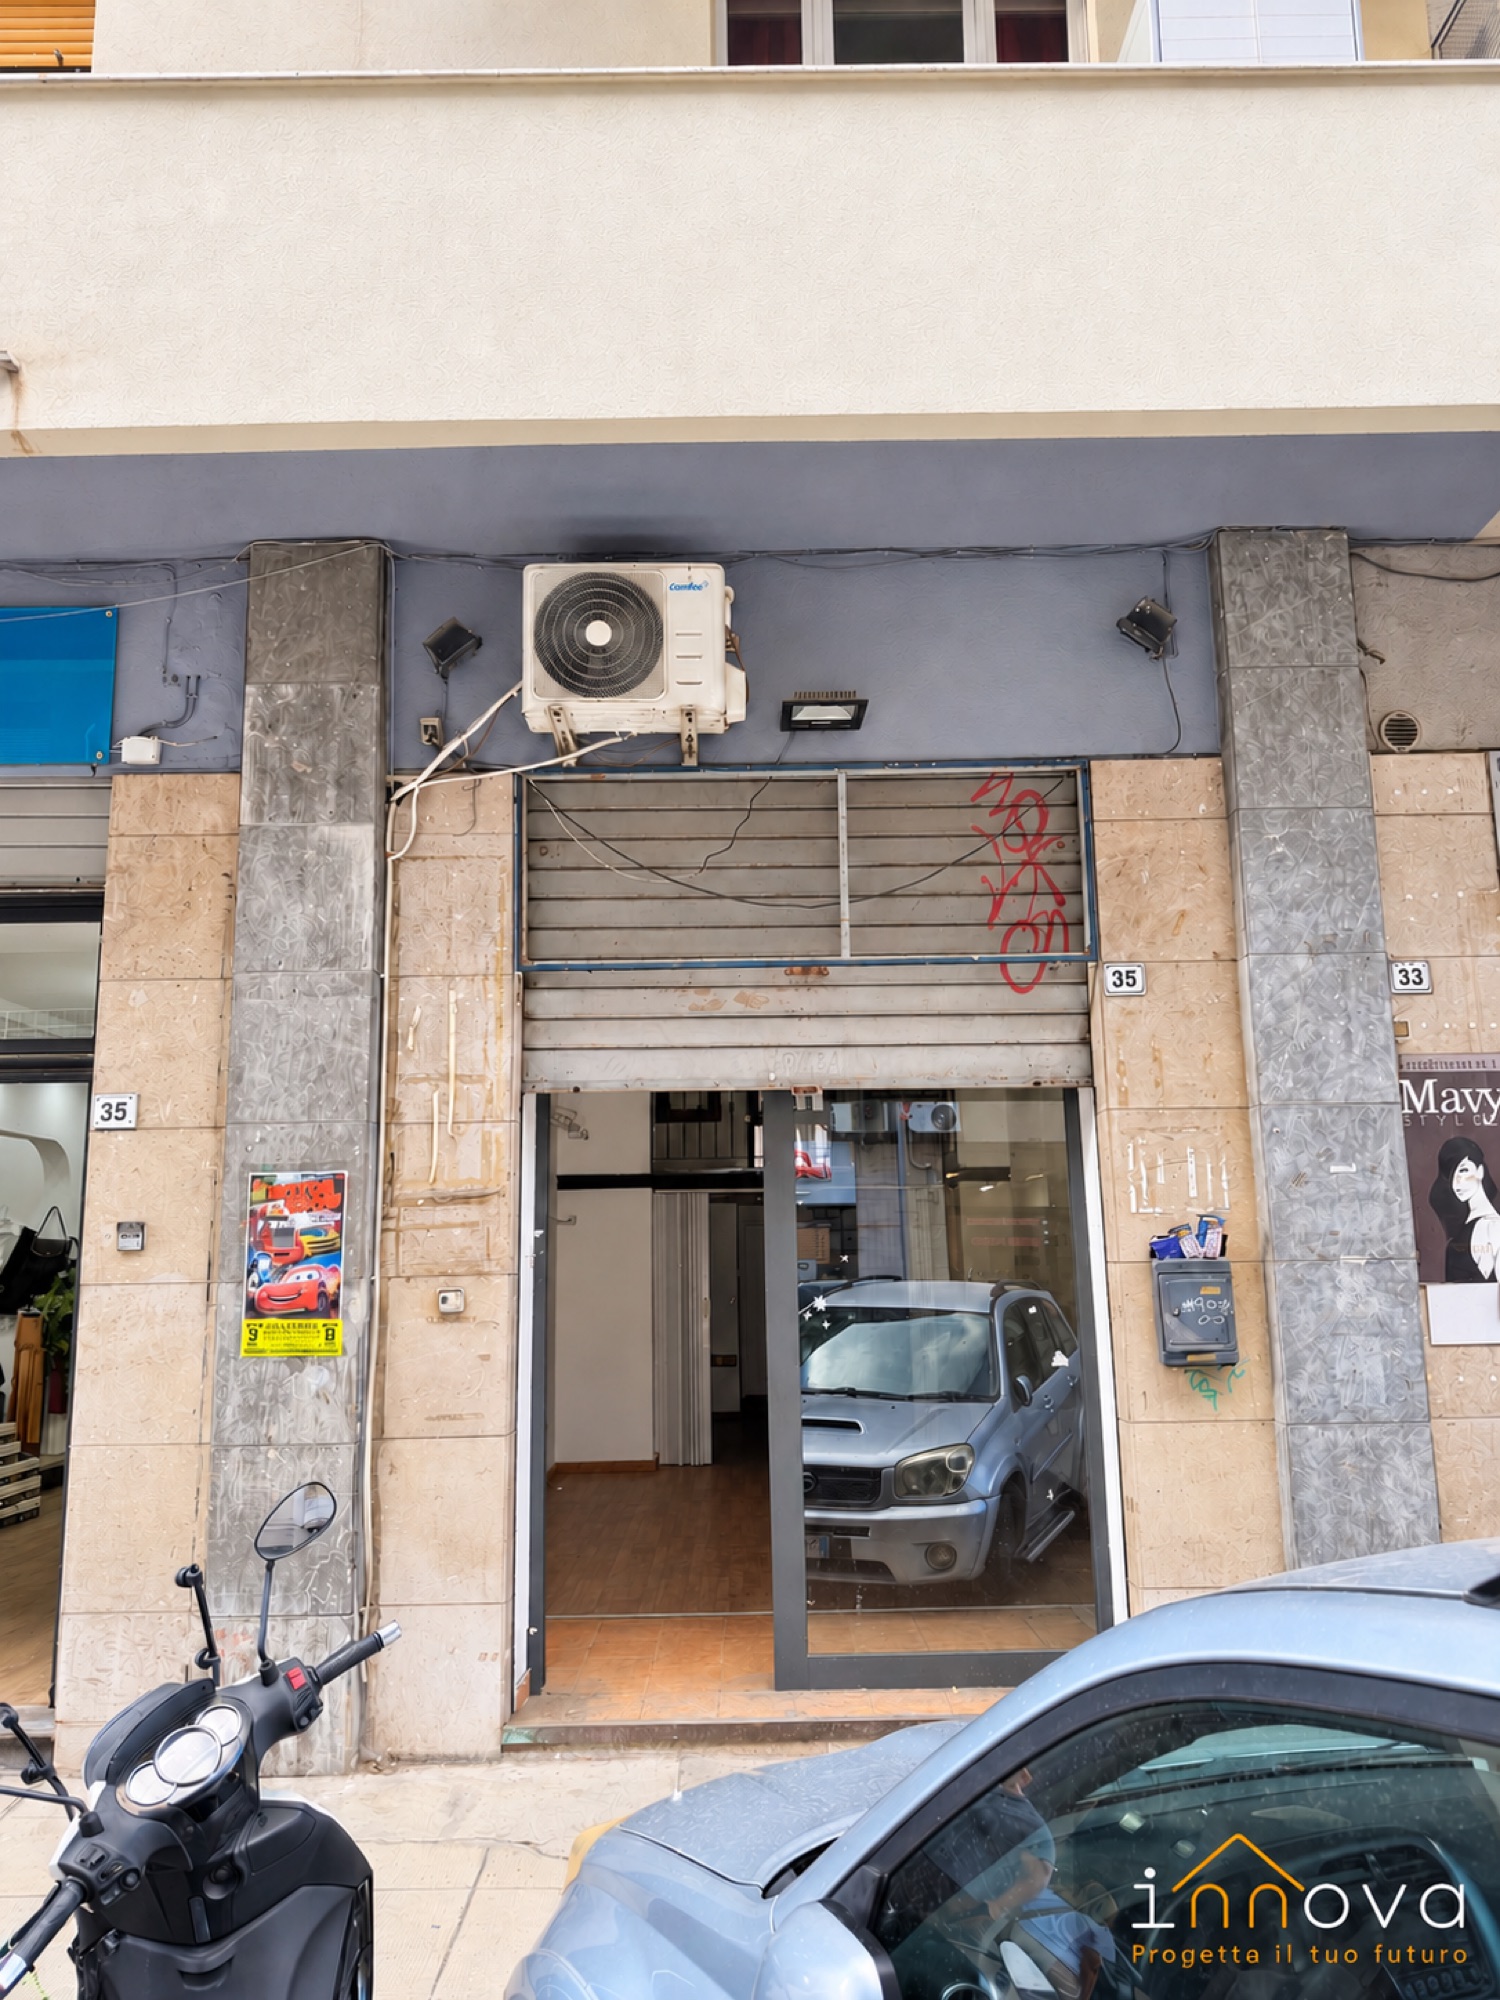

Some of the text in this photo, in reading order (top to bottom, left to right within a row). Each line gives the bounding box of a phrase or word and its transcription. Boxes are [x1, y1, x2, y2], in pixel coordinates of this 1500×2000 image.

[1111, 969, 1137, 988] 35
[1398, 967, 1424, 986] 33
[100, 1101, 128, 1122] 35
[1399, 1078, 1500, 1126] Mavy
[248, 1328, 258, 1342] 9
